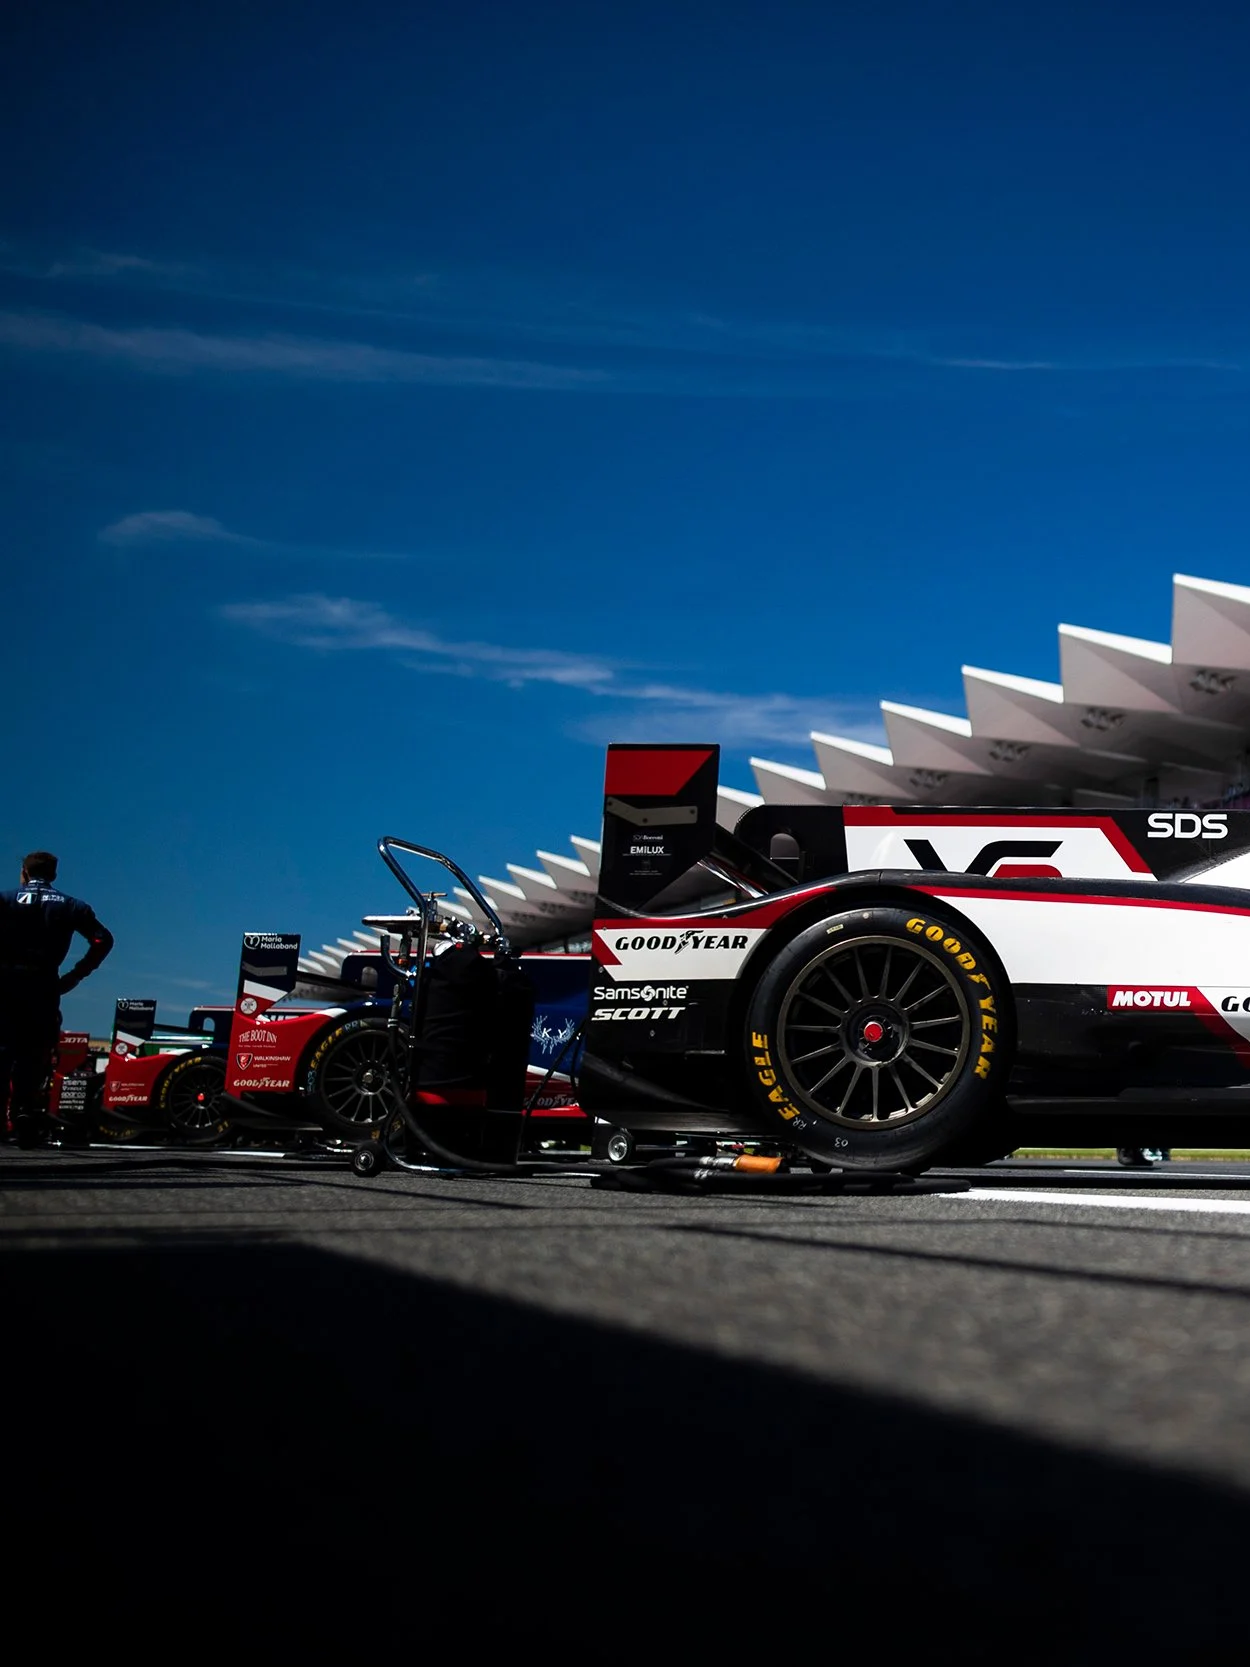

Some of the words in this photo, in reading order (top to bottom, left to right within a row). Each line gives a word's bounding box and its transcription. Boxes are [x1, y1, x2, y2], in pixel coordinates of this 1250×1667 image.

[1147, 813, 1228, 839] SDS
[593, 985, 687, 1001] Samsonite
[1112, 990, 1191, 1007] MOTUL
[591, 1006, 686, 1021] SCOTT
[239, 1031, 250, 1043] THE
[250, 1029, 267, 1042] BOOT
[541, 1027, 552, 1038] K
[557, 1028, 567, 1039] Y
[751, 1031, 801, 1121] EAGLE
